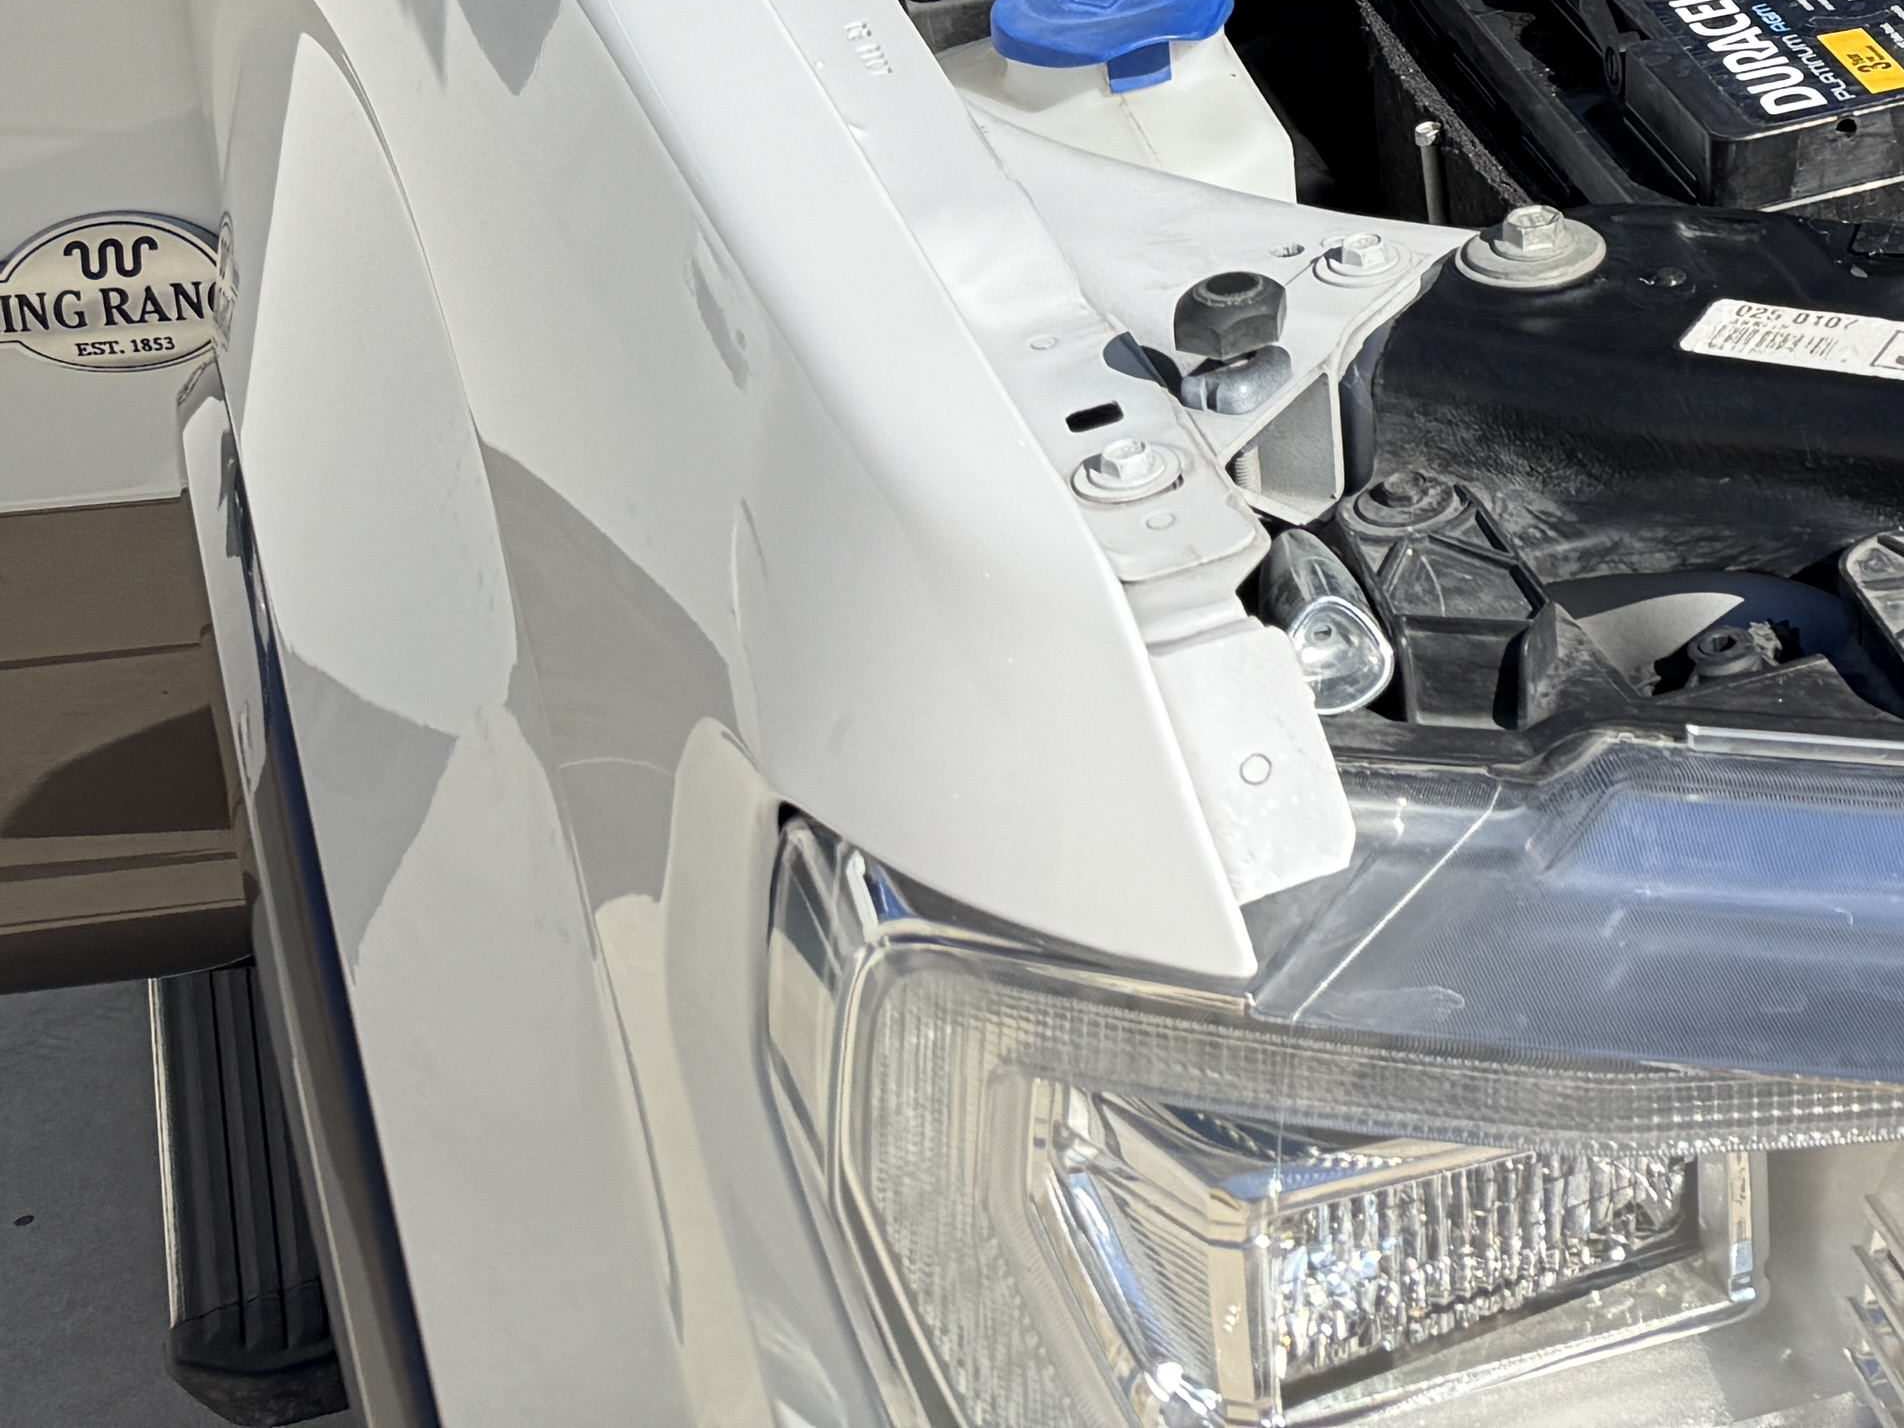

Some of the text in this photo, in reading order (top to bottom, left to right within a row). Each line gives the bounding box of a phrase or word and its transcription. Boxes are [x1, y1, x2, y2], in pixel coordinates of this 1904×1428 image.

[1781, 33, 1857, 102] PLATINUM
[1857, 61, 1892, 73] 3
[0, 281, 215, 334] ING RAN
[75, 336, 176, 357] EST. 1853
